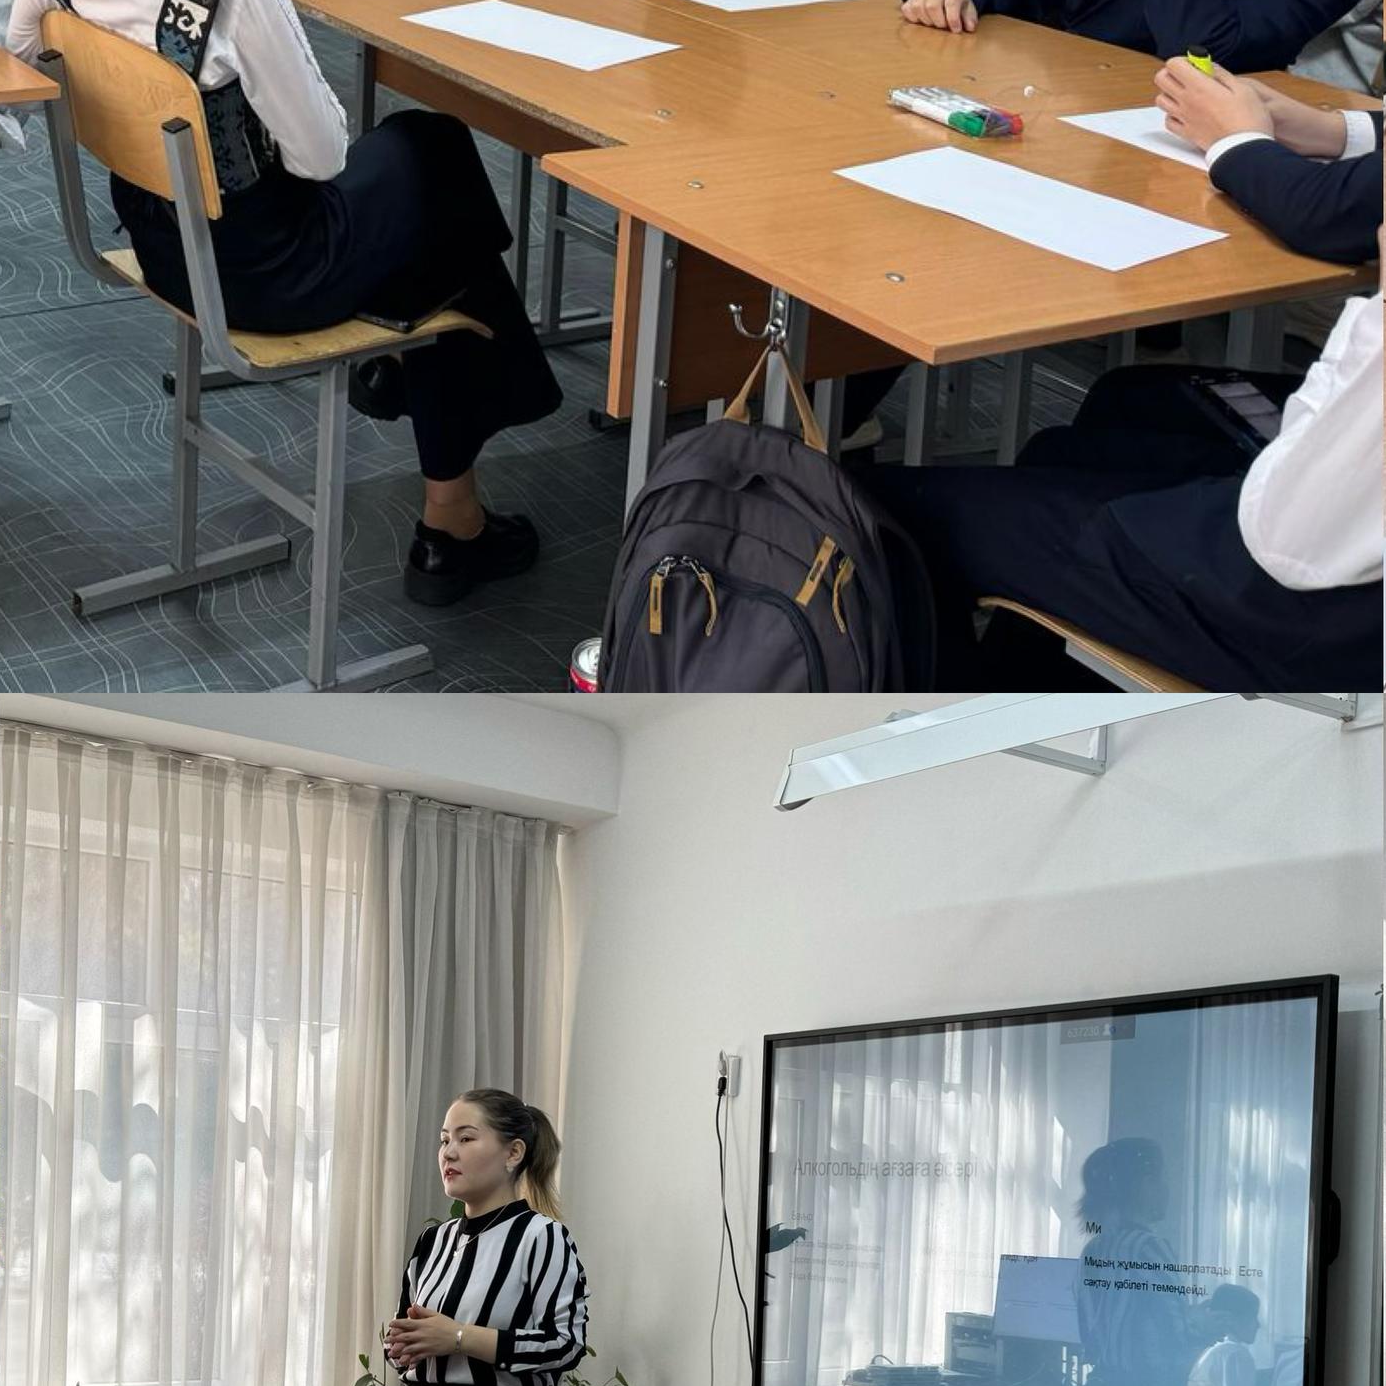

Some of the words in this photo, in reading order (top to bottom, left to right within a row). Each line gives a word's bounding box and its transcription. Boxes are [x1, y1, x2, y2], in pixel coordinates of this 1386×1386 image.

[792, 1159, 879, 1181] Алкогольдің
[881, 1161, 930, 1177] ағзаға
[1086, 1221, 1102, 1234] Ми
[1084, 1256, 1115, 1269] Мидың
[1117, 1259, 1161, 1271] жұмысын
[1239, 1266, 1263, 1277] Есте
[1083, 1277, 1111, 1291] сақтау
[1114, 1279, 1149, 1291] қабілеті
